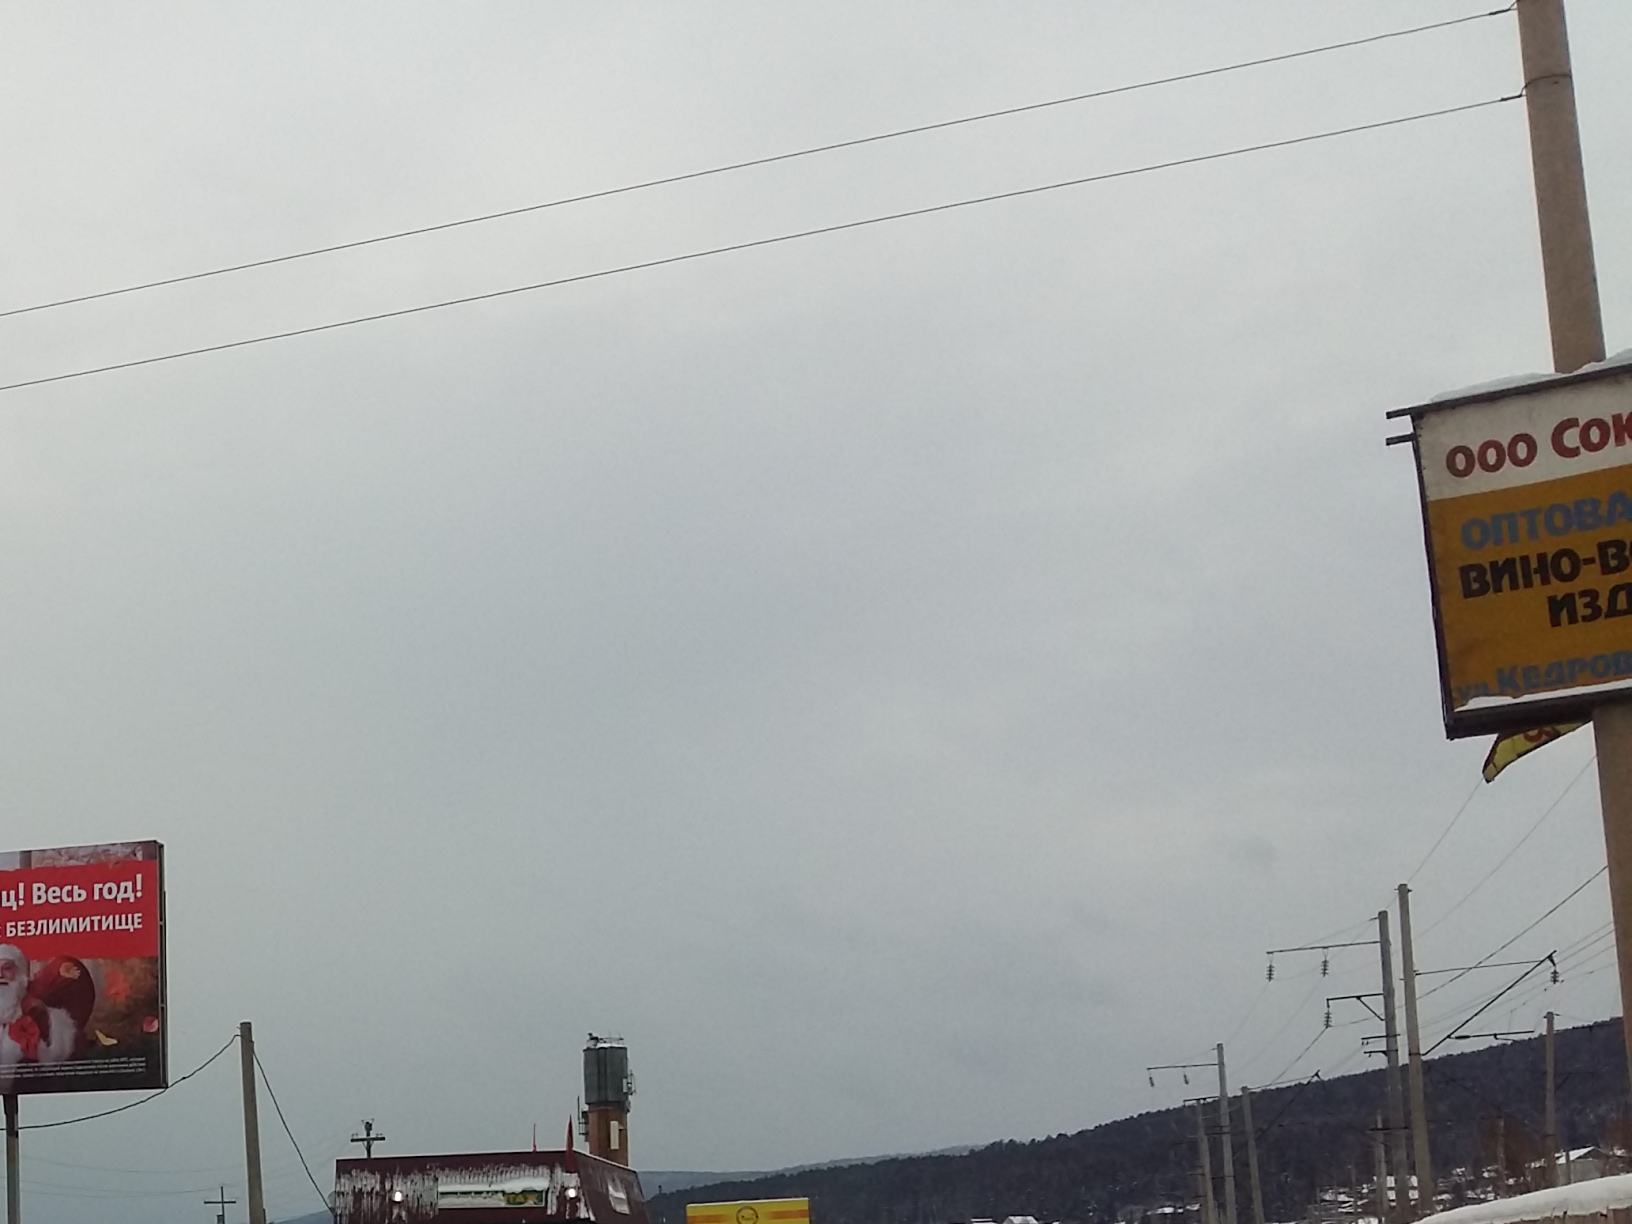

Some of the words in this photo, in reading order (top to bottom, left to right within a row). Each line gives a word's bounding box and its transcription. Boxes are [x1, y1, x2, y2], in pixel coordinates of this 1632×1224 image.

[1445, 433, 1538, 478] ООО
[1458, 539, 1632, 599] ВИНО-В
[31, 882, 87, 905] Весь
[93, 873, 143, 904] год!
[5, 913, 143, 938] БЕЗЛИМИТИЩЕ
